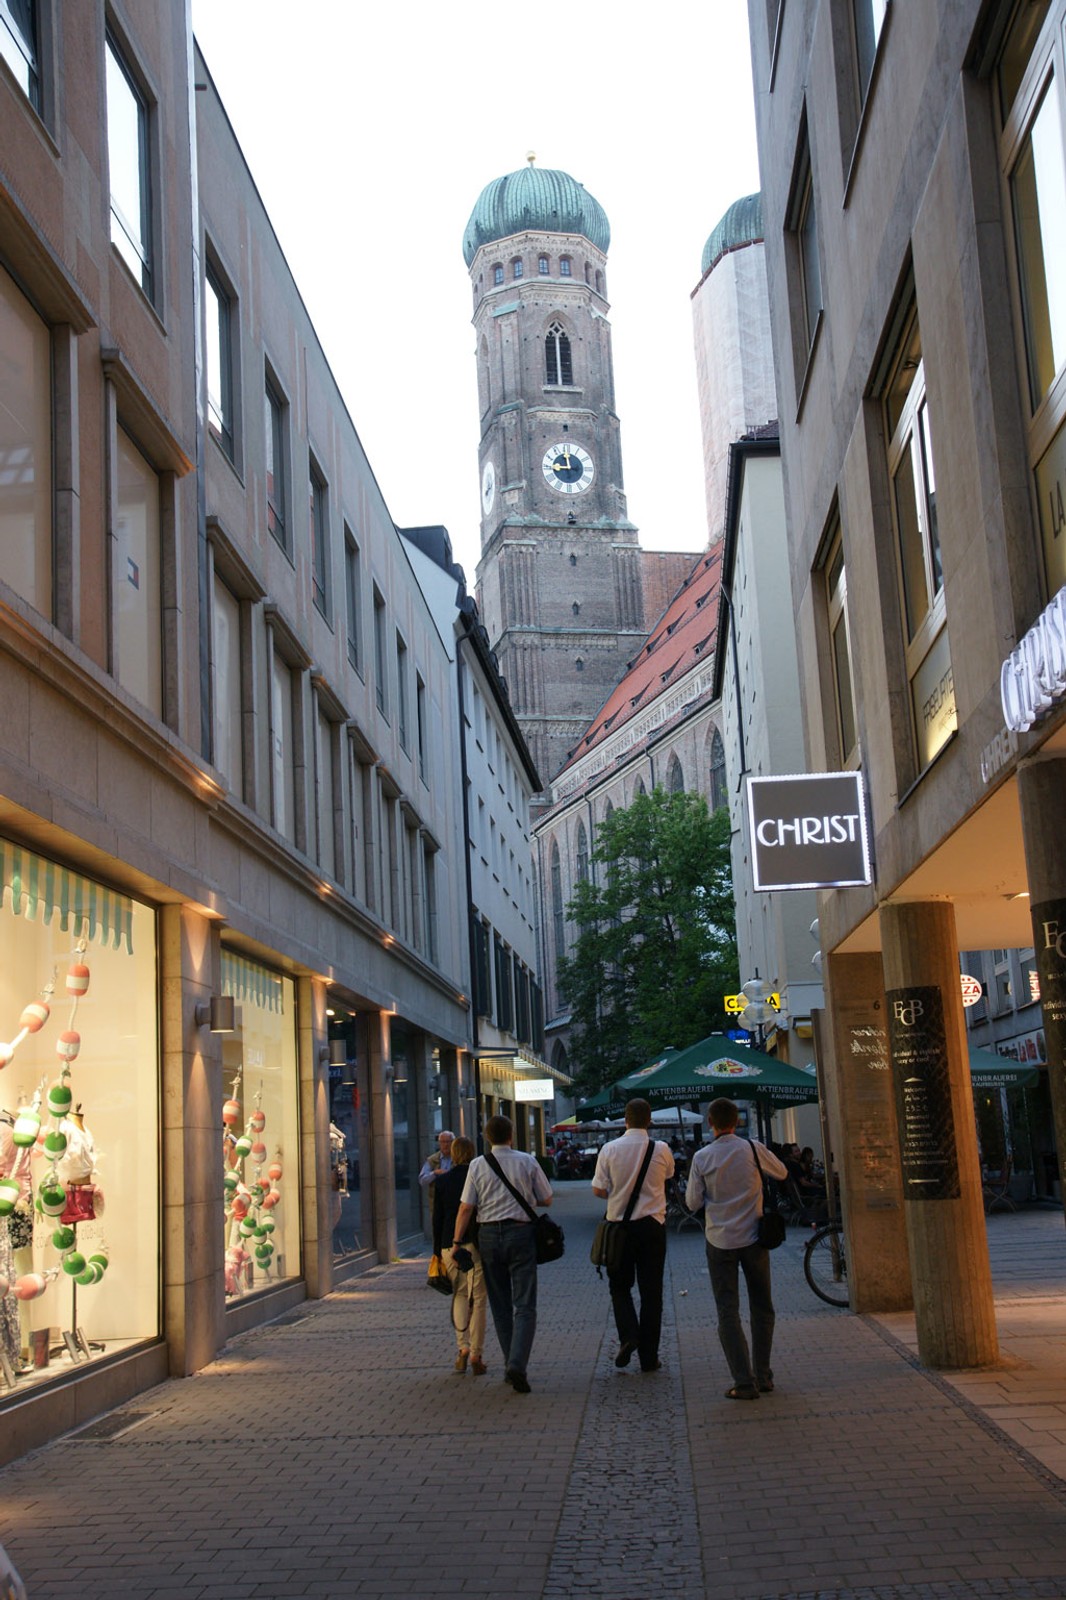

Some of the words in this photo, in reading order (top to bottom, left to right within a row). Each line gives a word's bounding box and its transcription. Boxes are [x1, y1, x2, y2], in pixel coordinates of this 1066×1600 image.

[757, 815, 858, 846] CHRIST
[873, 1000, 880, 1010] 6
[648, 1085, 714, 1096] AKTIENBRAUEREI
[756, 1085, 819, 1096] AKTIENBRAUERE
